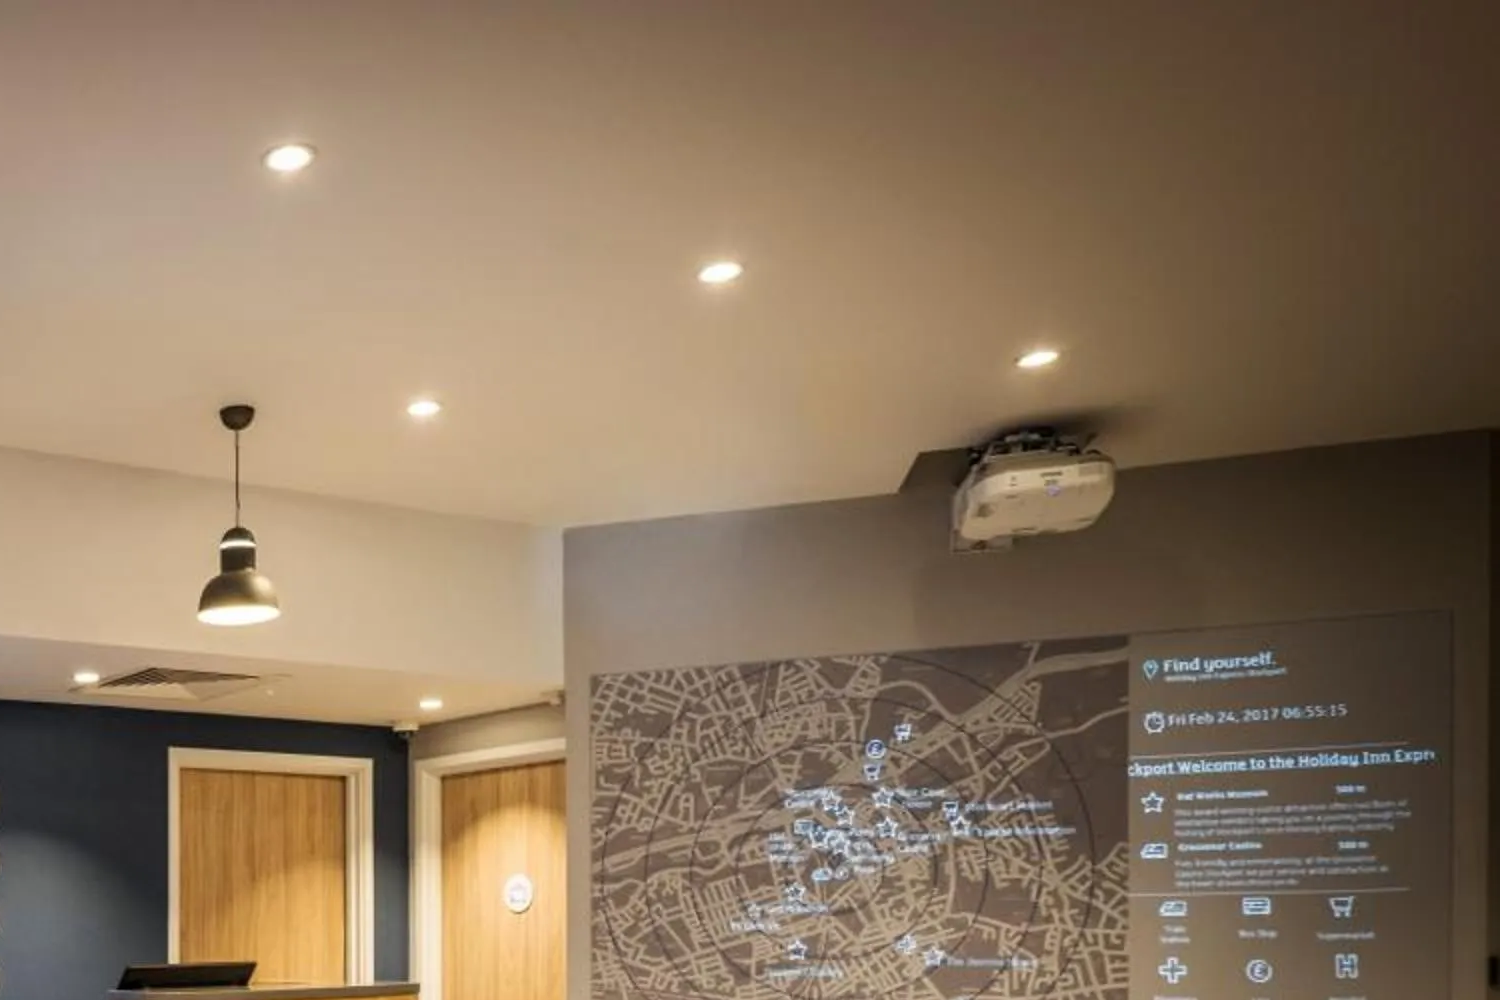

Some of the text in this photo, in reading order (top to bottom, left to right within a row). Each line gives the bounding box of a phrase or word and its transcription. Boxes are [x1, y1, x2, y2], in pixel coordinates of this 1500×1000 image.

[1163, 651, 1277, 673] Find yourself.
[1168, 713, 1186, 727] Fri
[1188, 711, 1214, 726] Feb
[1243, 708, 1278, 722] 2017
[1176, 758, 1248, 775] Welcome
[1250, 757, 1266, 771] to
[1269, 755, 1296, 770] the
[1299, 752, 1360, 768] Holiday
[1363, 751, 1392, 765] Inn
